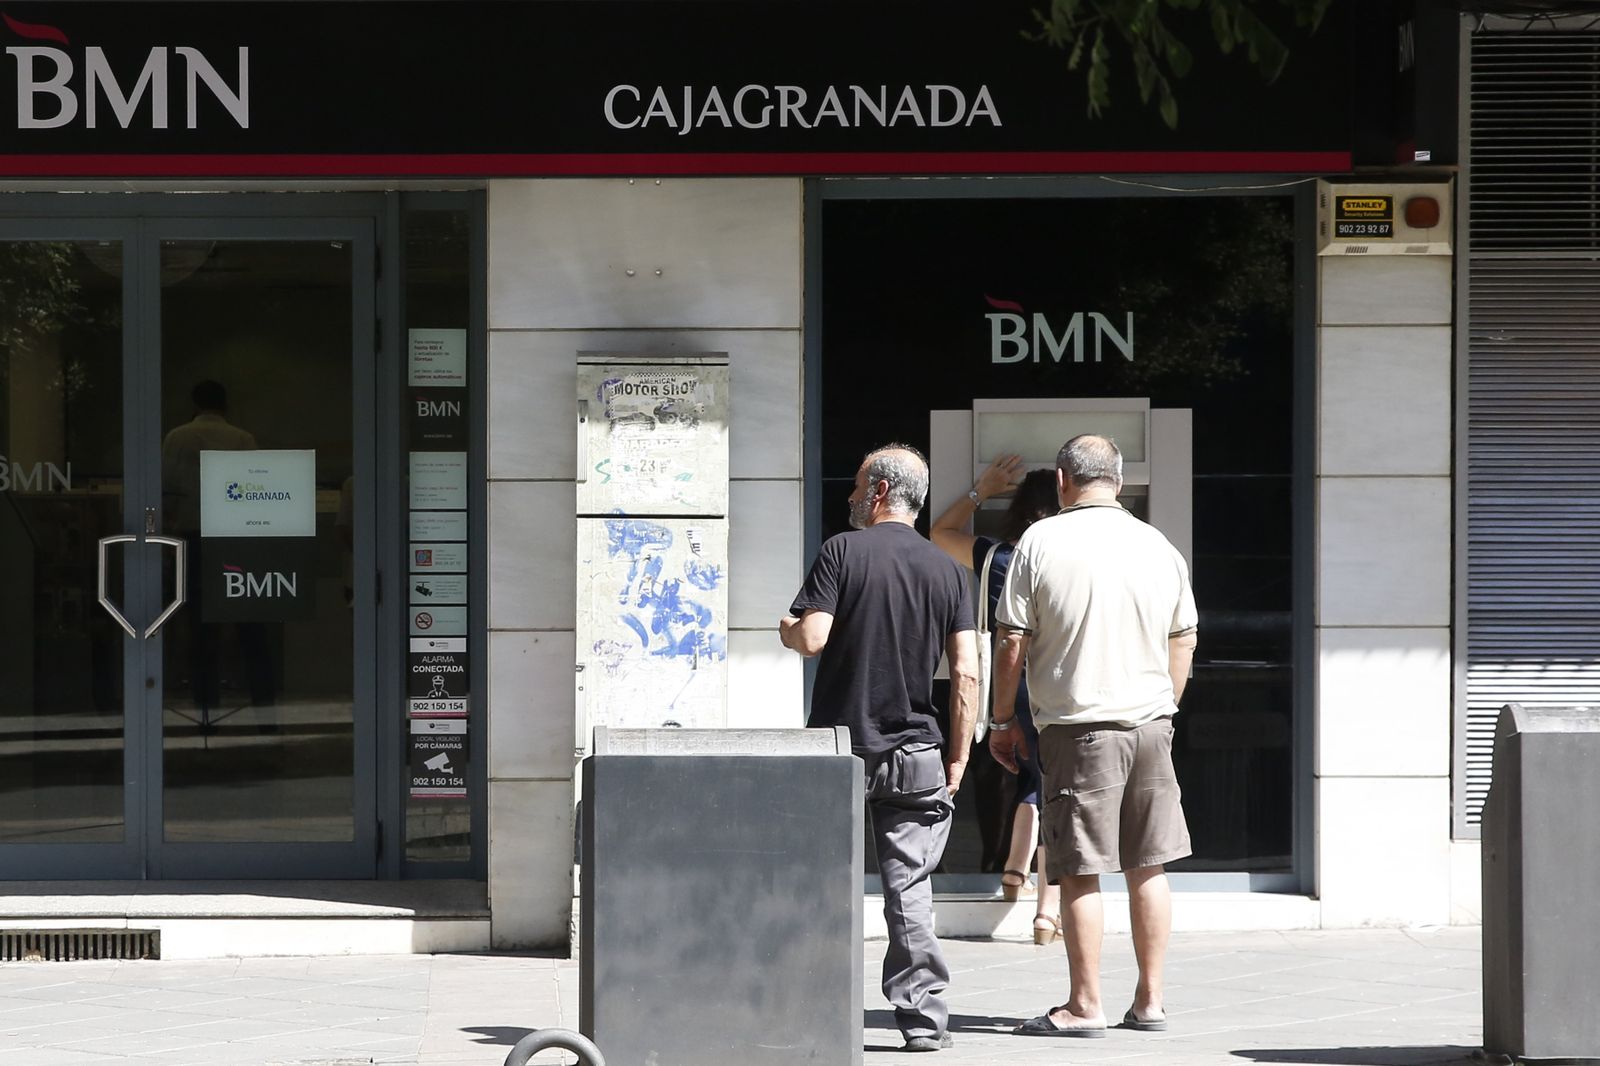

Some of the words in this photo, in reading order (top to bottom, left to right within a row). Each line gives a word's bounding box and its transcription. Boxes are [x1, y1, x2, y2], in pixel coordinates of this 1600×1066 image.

[6, 46, 249, 129] BMN
[604, 84, 1003, 136] CAJAGRANADA
[1339, 224, 1354, 234] 902
[1355, 224, 1366, 234] 23
[1367, 224, 1378, 234] 92
[1379, 224, 1390, 234] 87
[984, 311, 1135, 364] BMN
[614, 382, 658, 396] MOTOR
[416, 400, 461, 417] BMN
[246, 491, 291, 501] GRANADA
[223, 571, 297, 598] BMN
[422, 655, 455, 663] ALARMA
[412, 665, 464, 673] CONECTADA
[413, 702, 429, 710] 902
[431, 702, 446, 710] 150
[449, 702, 464, 710] 154
[413, 777, 429, 786] 902
[431, 777, 446, 786] 150
[448, 777, 464, 786] 154
